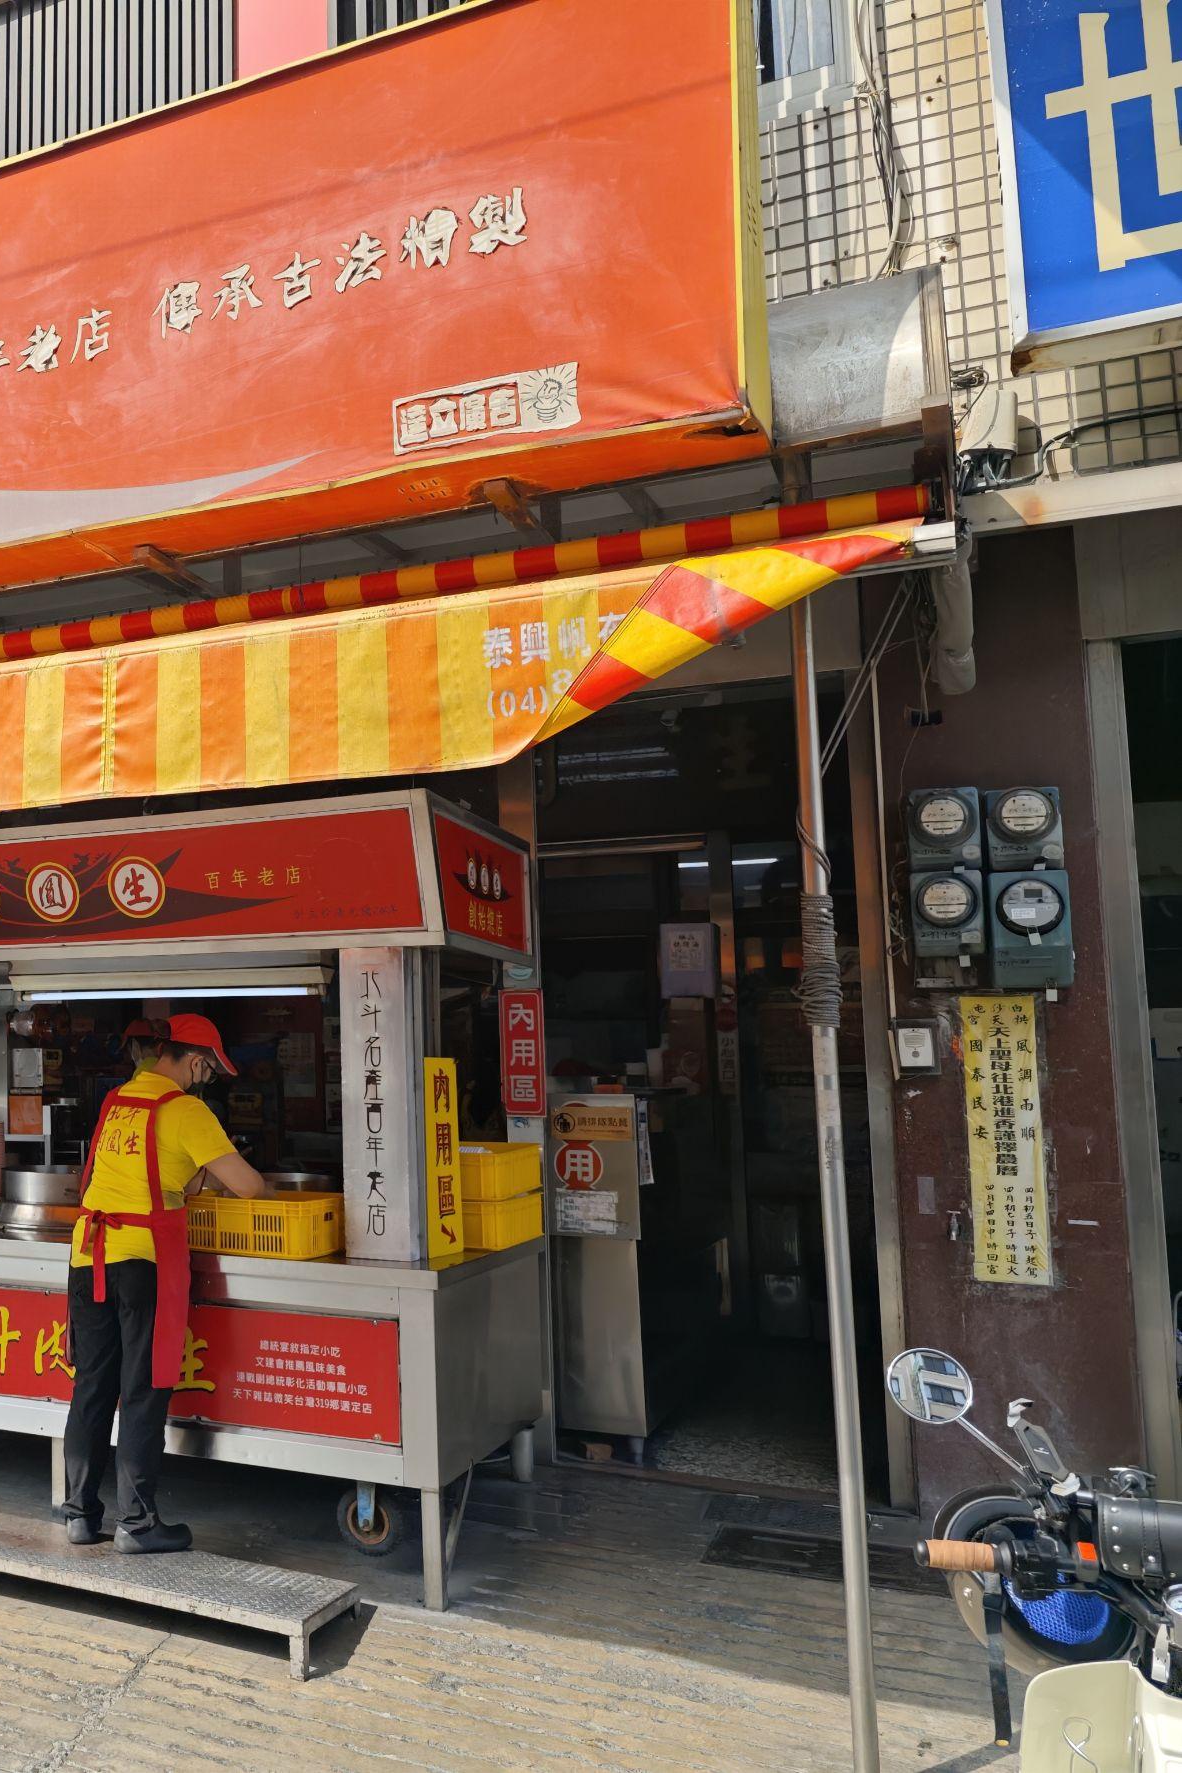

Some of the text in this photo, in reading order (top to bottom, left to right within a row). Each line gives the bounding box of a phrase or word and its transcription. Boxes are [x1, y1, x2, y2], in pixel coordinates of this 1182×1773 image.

[152, 187, 529, 339] 傳承古法精製
[204, 865, 302, 890] 百年老店
[360, 970, 387, 1237] 北斗名產百年老店
[508, 1003, 537, 1103] 內用區
[969, 1039, 989, 1140] 國泰民安
[1016, 1039, 1036, 1142] 風調雨順
[433, 1068, 456, 1219] 內用區
